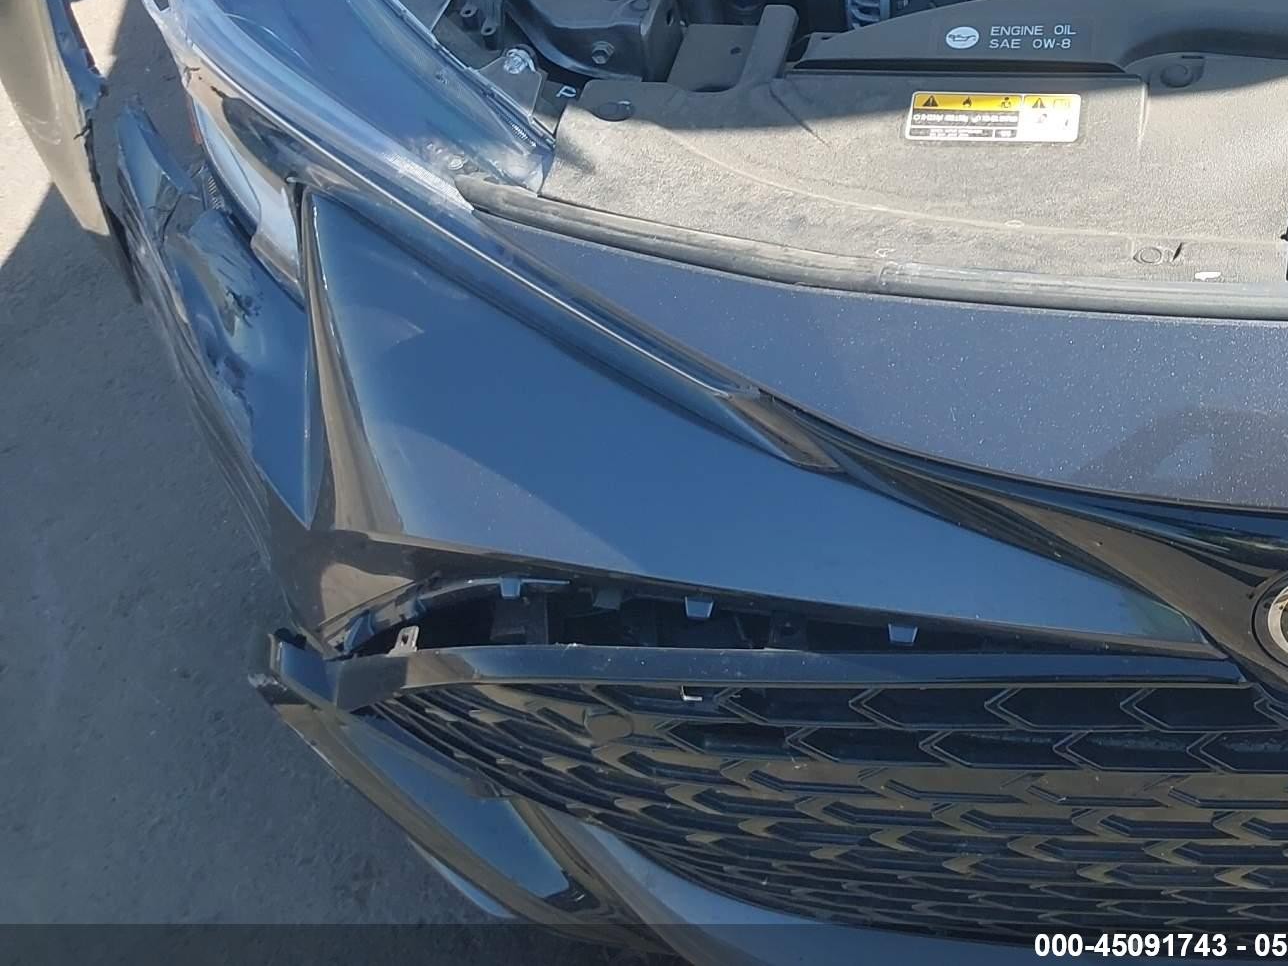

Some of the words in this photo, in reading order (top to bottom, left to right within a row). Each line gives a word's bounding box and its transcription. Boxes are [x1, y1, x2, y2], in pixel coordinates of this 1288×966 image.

[990, 25, 1044, 36] ENGINE
[1054, 24, 1077, 35] OIL
[989, 38, 1021, 49] SAE
